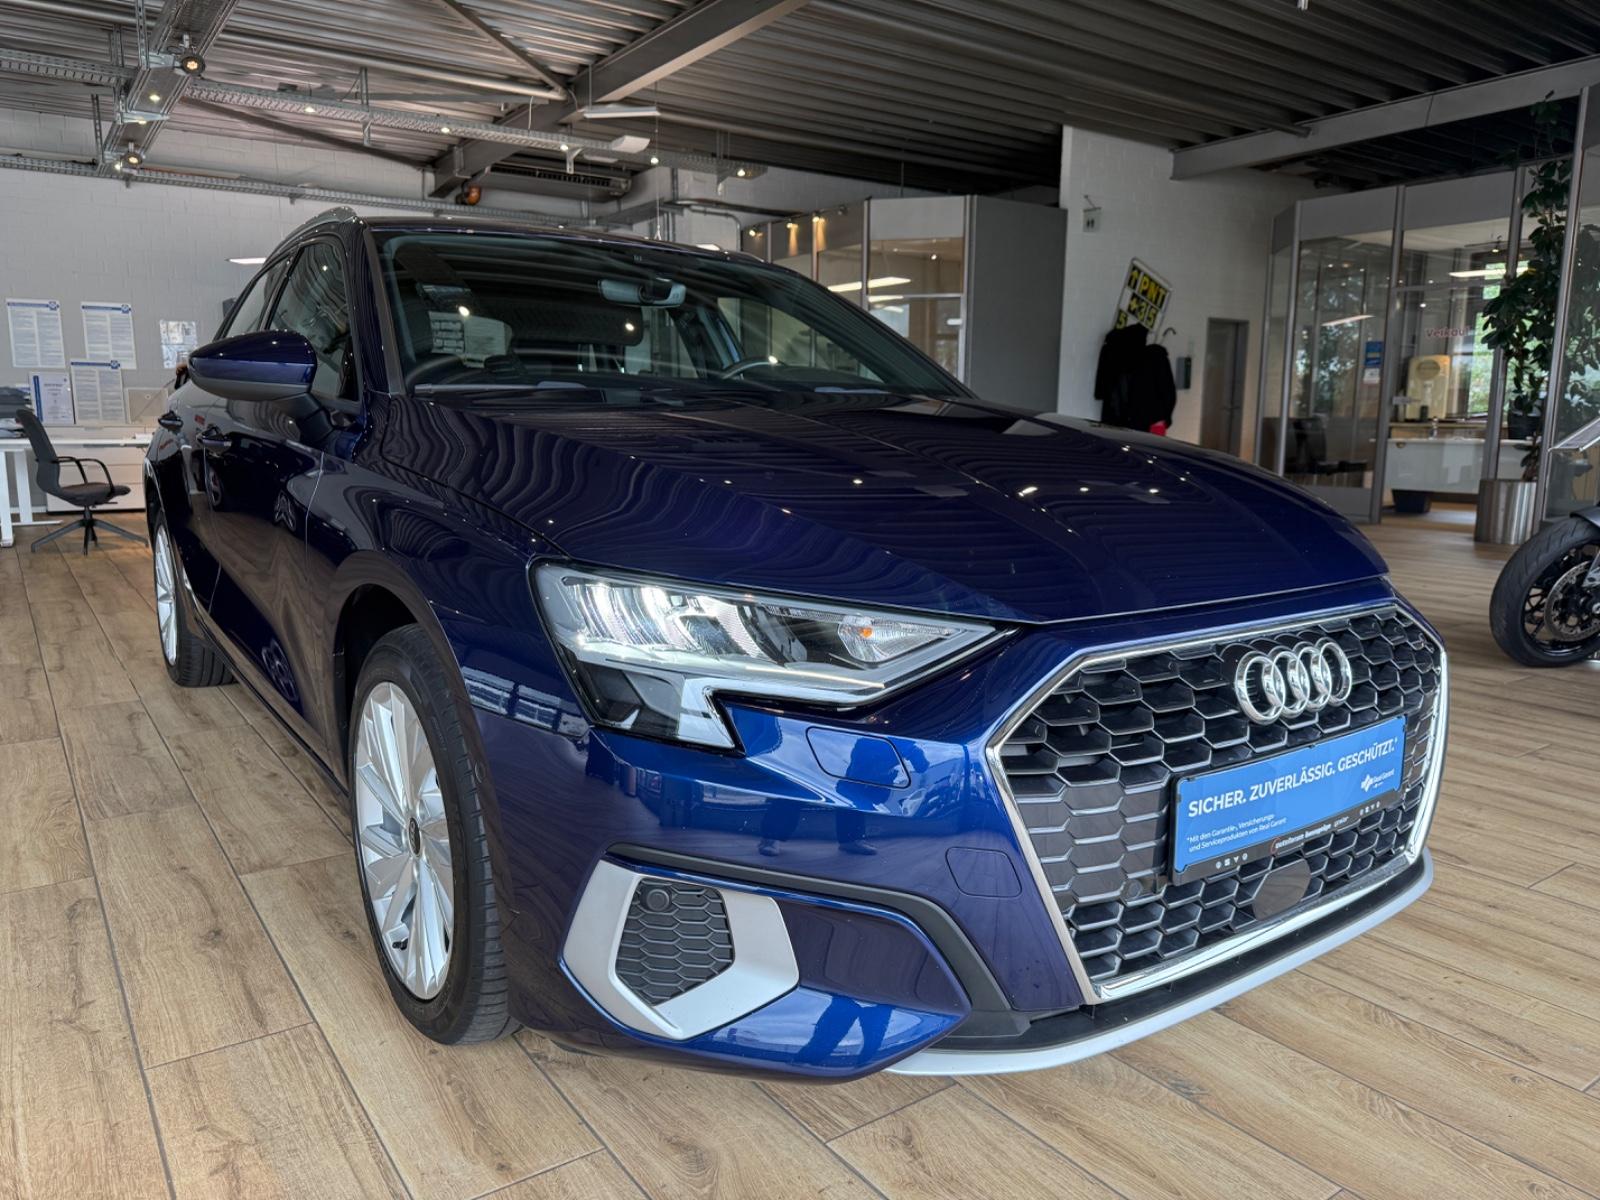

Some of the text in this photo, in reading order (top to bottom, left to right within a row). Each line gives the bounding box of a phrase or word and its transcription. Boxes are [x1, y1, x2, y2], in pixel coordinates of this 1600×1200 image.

[1188, 791, 1247, 818] SICHER.
[1250, 761, 1336, 800] ZUVERLÄSSIG.
[1189, 844, 1201, 853] und
